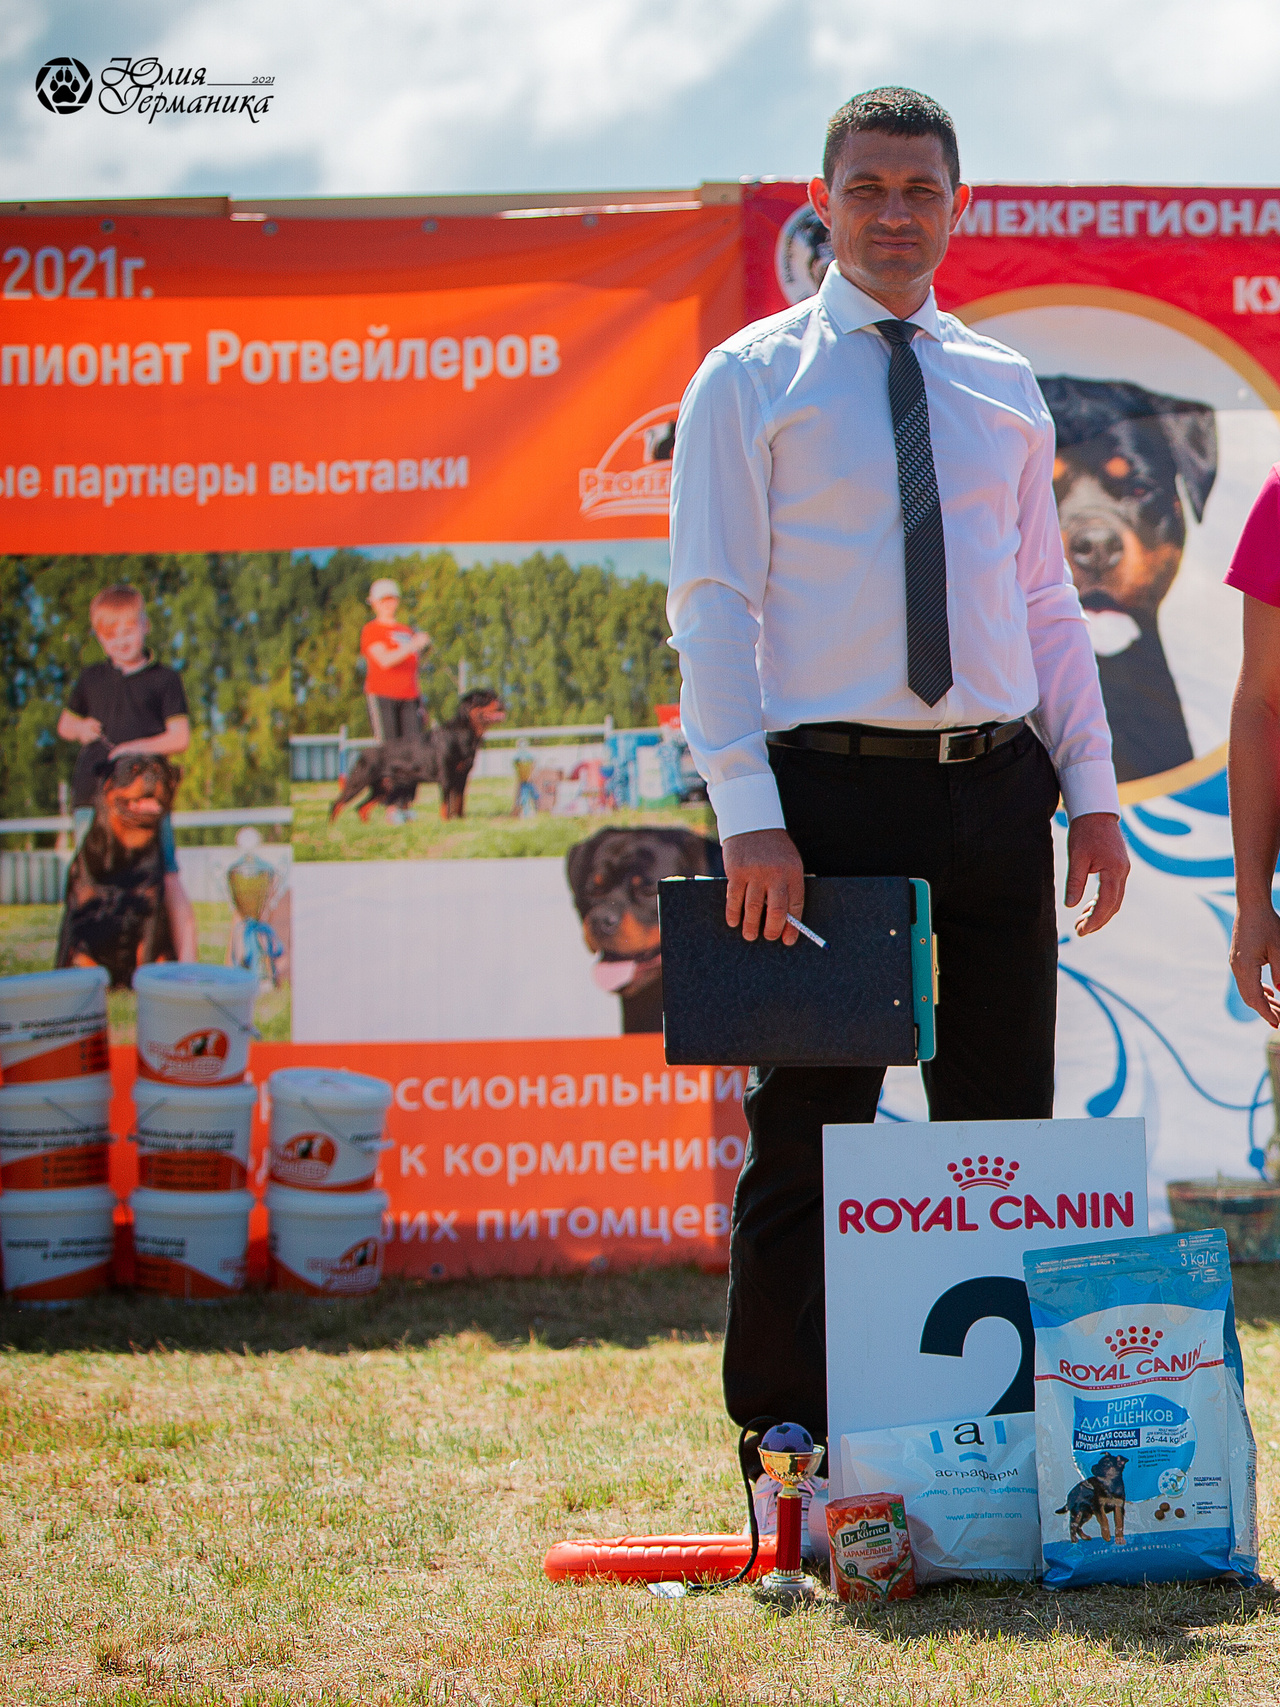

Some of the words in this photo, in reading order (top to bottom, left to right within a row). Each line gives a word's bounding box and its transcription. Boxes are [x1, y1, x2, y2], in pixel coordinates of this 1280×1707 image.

[2, 246, 154, 299] 2021г.
[206, 324, 561, 391] Ротвейлеров
[53, 462, 257, 507] партнеры
[269, 456, 469, 496] выставки
[394, 1066, 743, 1112] ссиональный
[401, 1142, 427, 1177] к
[444, 1134, 745, 1186] кормлению
[476, 1202, 732, 1246] питомцев
[838, 1195, 979, 1235] ROYAL
[989, 1190, 1135, 1231] CANIN
[1180, 1253, 1188, 1267] 3
[919, 1275, 1036, 1417] 2
[1059, 1358, 1131, 1382] ROYAL
[1136, 1342, 1203, 1376] CANIN
[1080, 1415, 1110, 1431] ДЛЯ
[1113, 1409, 1174, 1426] ЩЕНКОВ
[1107, 1396, 1147, 1414] PUPPY
[1075, 1440, 1105, 1449] КРУПНЫХ
[1105, 1438, 1138, 1447] РАЗМЕРОВ
[1078, 1432, 1094, 1440] MAXI
[1113, 1430, 1136, 1439] СОБАК
[1145, 1435, 1168, 1443] 26-44
[935, 1467, 1019, 1482] астрафарм
[945, 1511, 1022, 1521] www.astrafarm.com
[842, 1545, 893, 1558] КАРАМЕЛЬНЫЕ
